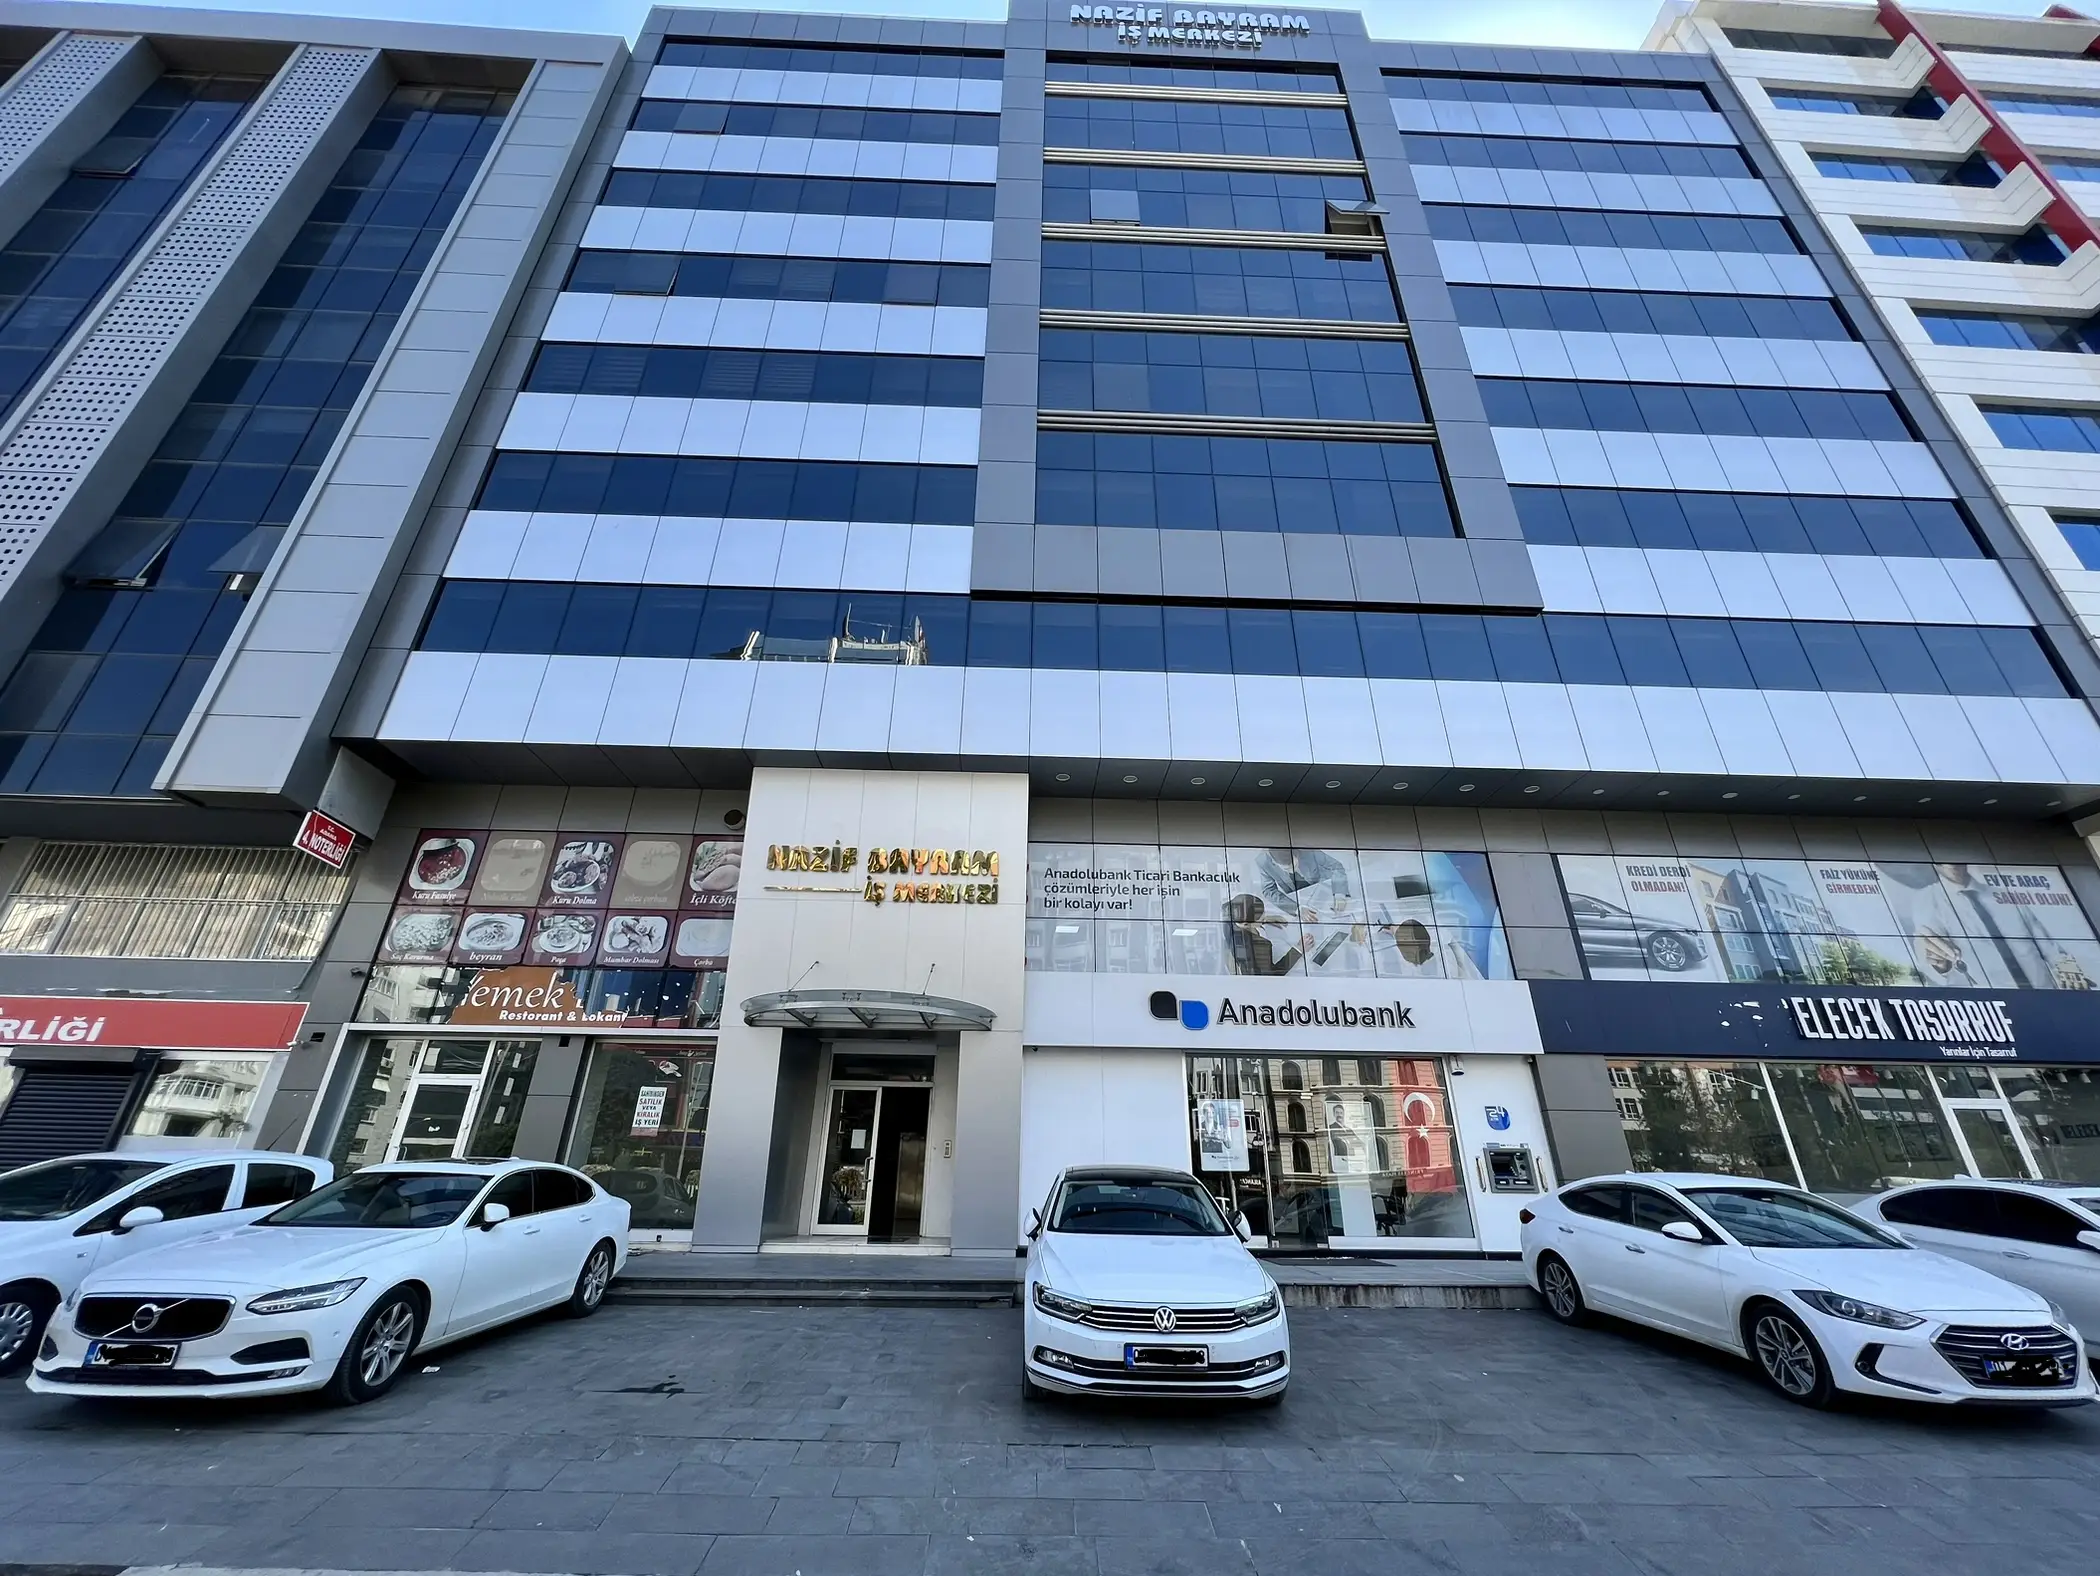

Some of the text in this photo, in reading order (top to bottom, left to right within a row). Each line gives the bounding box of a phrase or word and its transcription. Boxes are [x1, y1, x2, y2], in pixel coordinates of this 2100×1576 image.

[1070, 4, 1310, 33] NAZİF BAYRAM
[1118, 22, 1263, 49] İŞ MERKEZİ
[767, 839, 999, 876] NAZİF BAYRAM
[1044, 867, 1240, 883] Anadolubank Ticari Bankacılık
[1626, 864, 1691, 878] KREDİ DERDİ
[1820, 868, 1880, 882] FAİZ YÜKÜNE
[1631, 880, 1686, 893] OLMADAN!
[1826, 883, 1879, 895] GİRMEDEN!
[2016, 875, 2050, 890] ARAÇ
[864, 875, 999, 906] İŞ MERKEZİ
[1044, 883, 1180, 899] çözümleriyle her işin
[552, 896, 597, 905] Kuru Dolma
[1044, 897, 1133, 912] bir kolayı var!
[469, 952, 502, 962] beyran
[499, 1009, 562, 1021] Restorant
[566, 1011, 577, 1021] &
[1217, 997, 1416, 1029] Anadolubank
[1889, 998, 2016, 1042] TASARRUF
